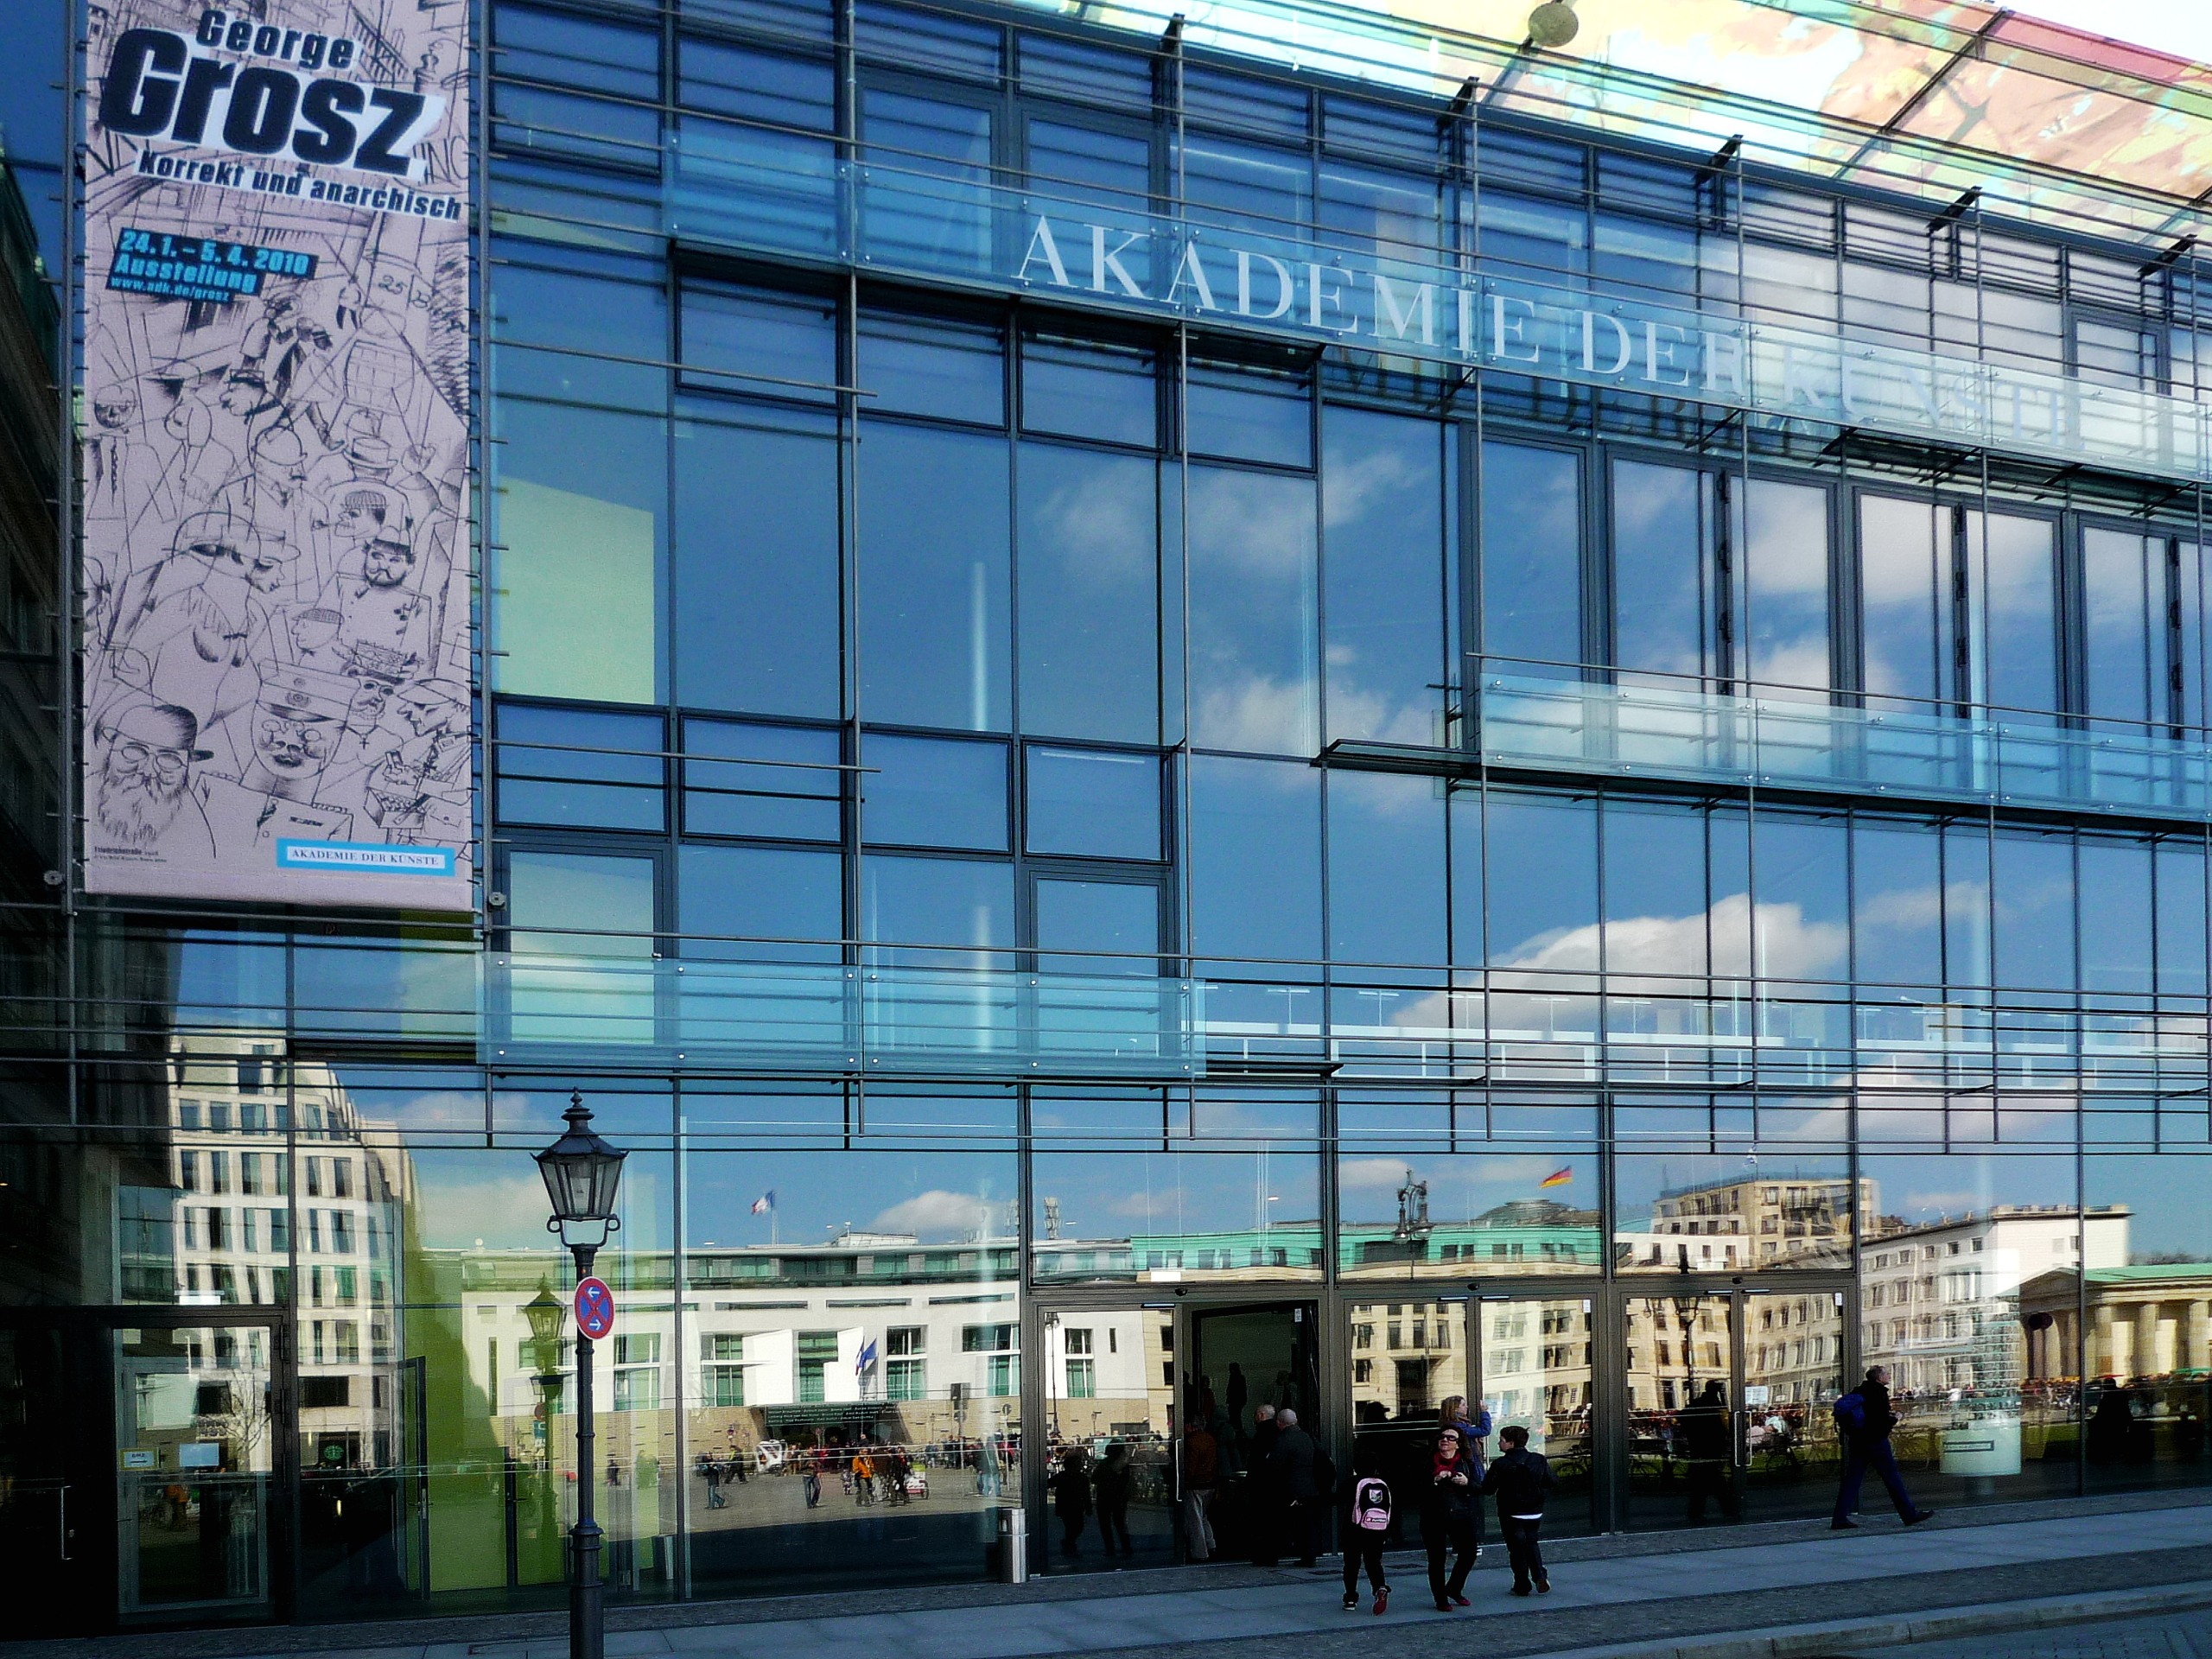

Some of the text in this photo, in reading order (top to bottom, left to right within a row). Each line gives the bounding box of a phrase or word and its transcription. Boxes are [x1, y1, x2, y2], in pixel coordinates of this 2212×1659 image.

[196, 10, 355, 70] George
[99, 28, 426, 176] Grosz
[138, 149, 461, 221] Korrekt und anarchisch
[114, 252, 257, 294] Ausstellung
[1010, 215, 1540, 363] AKADEMIE
[1575, 309, 1745, 397] DER
[292, 849, 358, 861] AKADEMIE
[361, 853, 387, 863] DER
